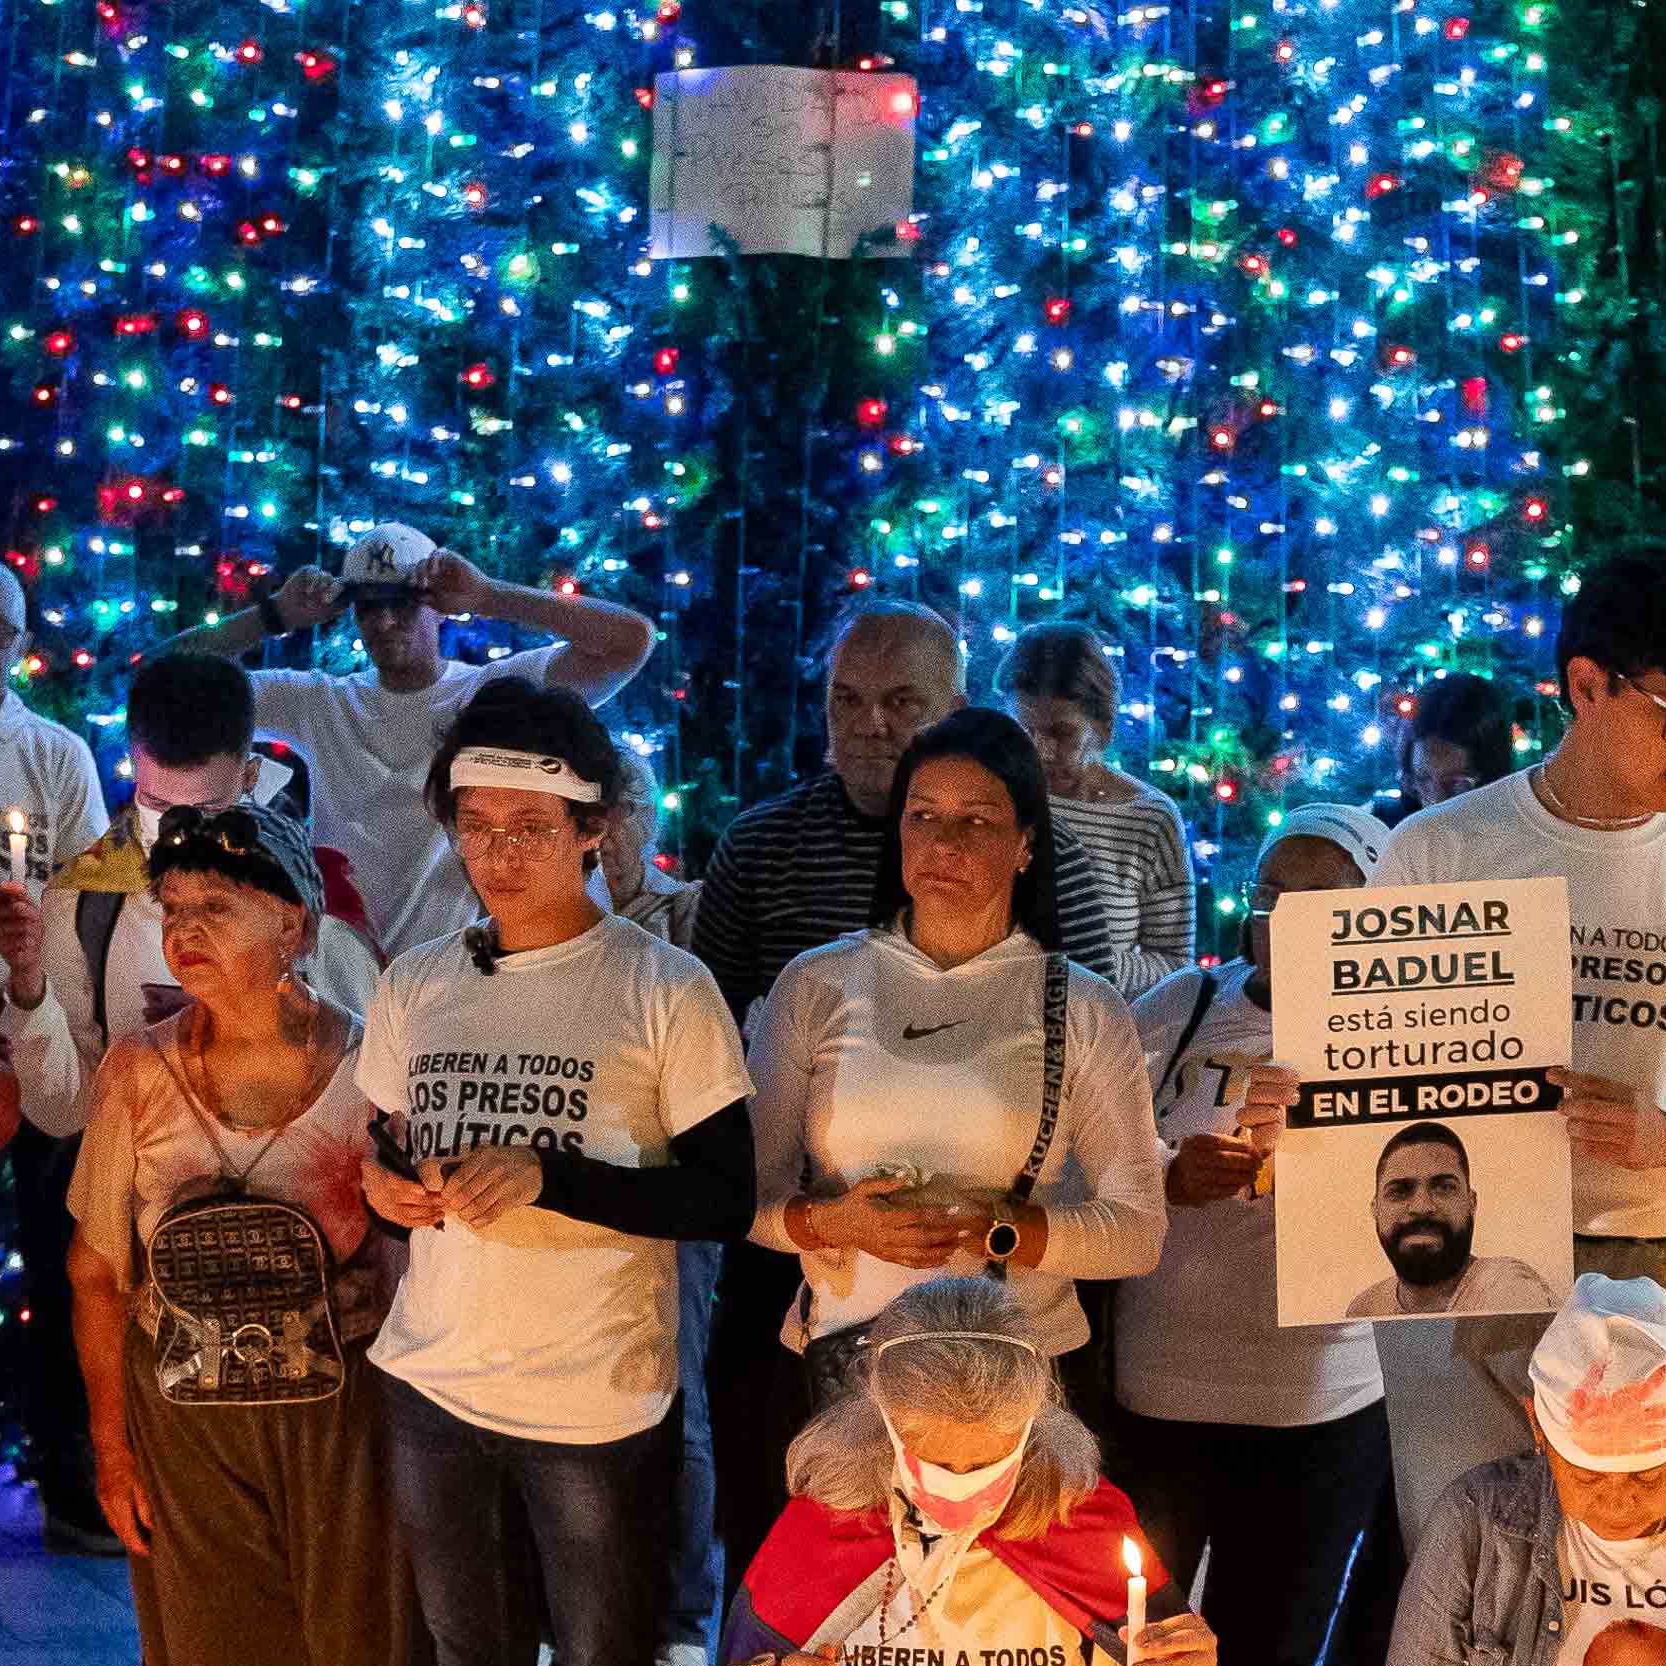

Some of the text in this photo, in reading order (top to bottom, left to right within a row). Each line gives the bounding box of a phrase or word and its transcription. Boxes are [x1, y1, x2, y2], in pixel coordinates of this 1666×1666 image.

[1331, 900, 1510, 940] JOSNAR
[1590, 927, 1607, 947] A
[1332, 950, 1514, 990] BADUEL
[1327, 999, 1511, 1033] está siendo
[409, 1052, 595, 1083] LIBEREN A TODOS
[1324, 1030, 1524, 1072] torturado
[457, 1080, 589, 1122] PRESOS
[1312, 1079, 1540, 1119] EN EL RODEO
